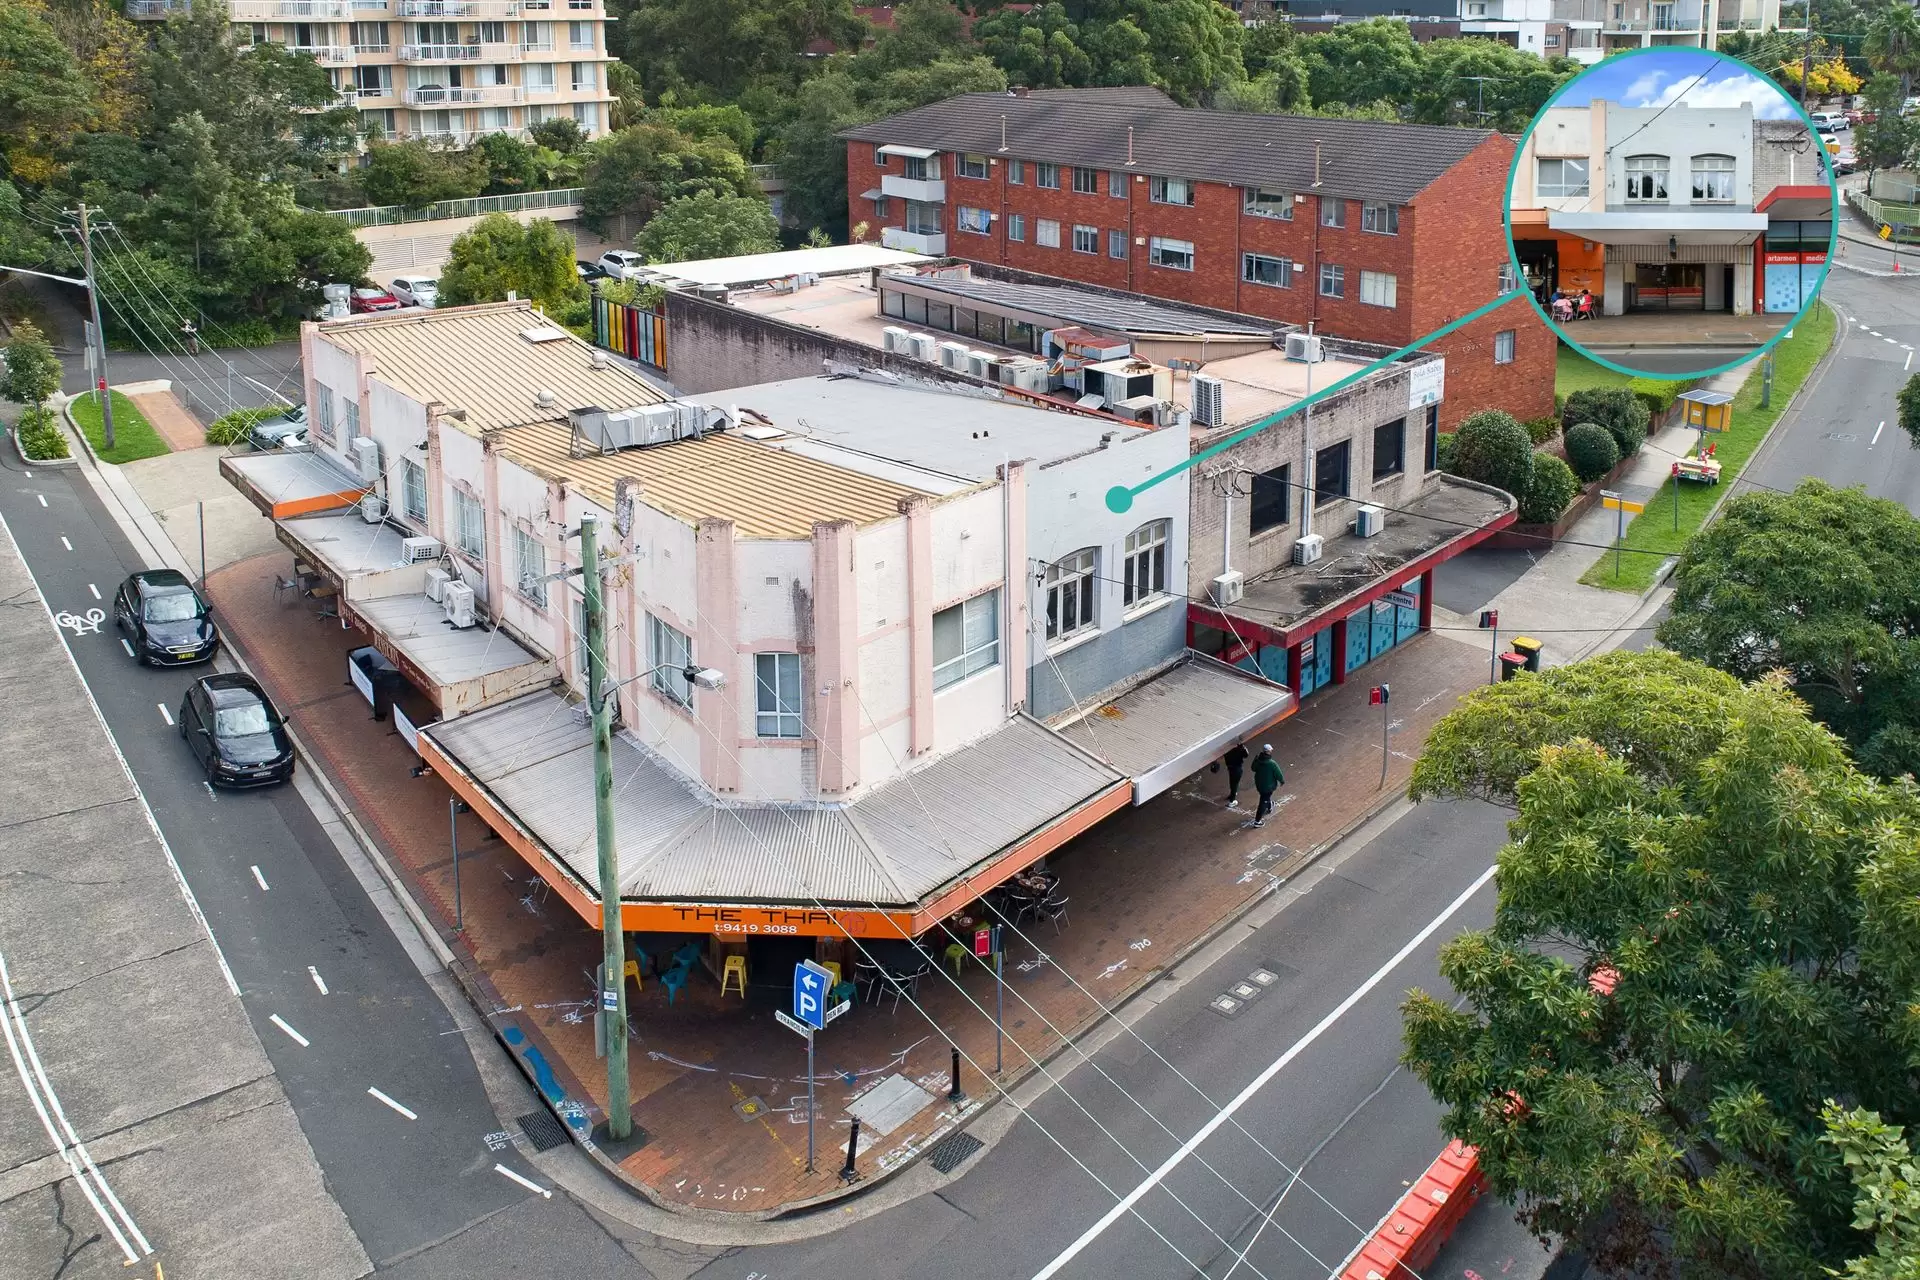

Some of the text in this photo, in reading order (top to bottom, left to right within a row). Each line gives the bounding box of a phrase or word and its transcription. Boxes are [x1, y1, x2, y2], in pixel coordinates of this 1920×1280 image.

[1767, 254, 1797, 262] artarmon
[673, 908, 838, 925] THE THAI
[713, 923, 798, 934] t:9419 3088
[800, 991, 817, 1017] P
